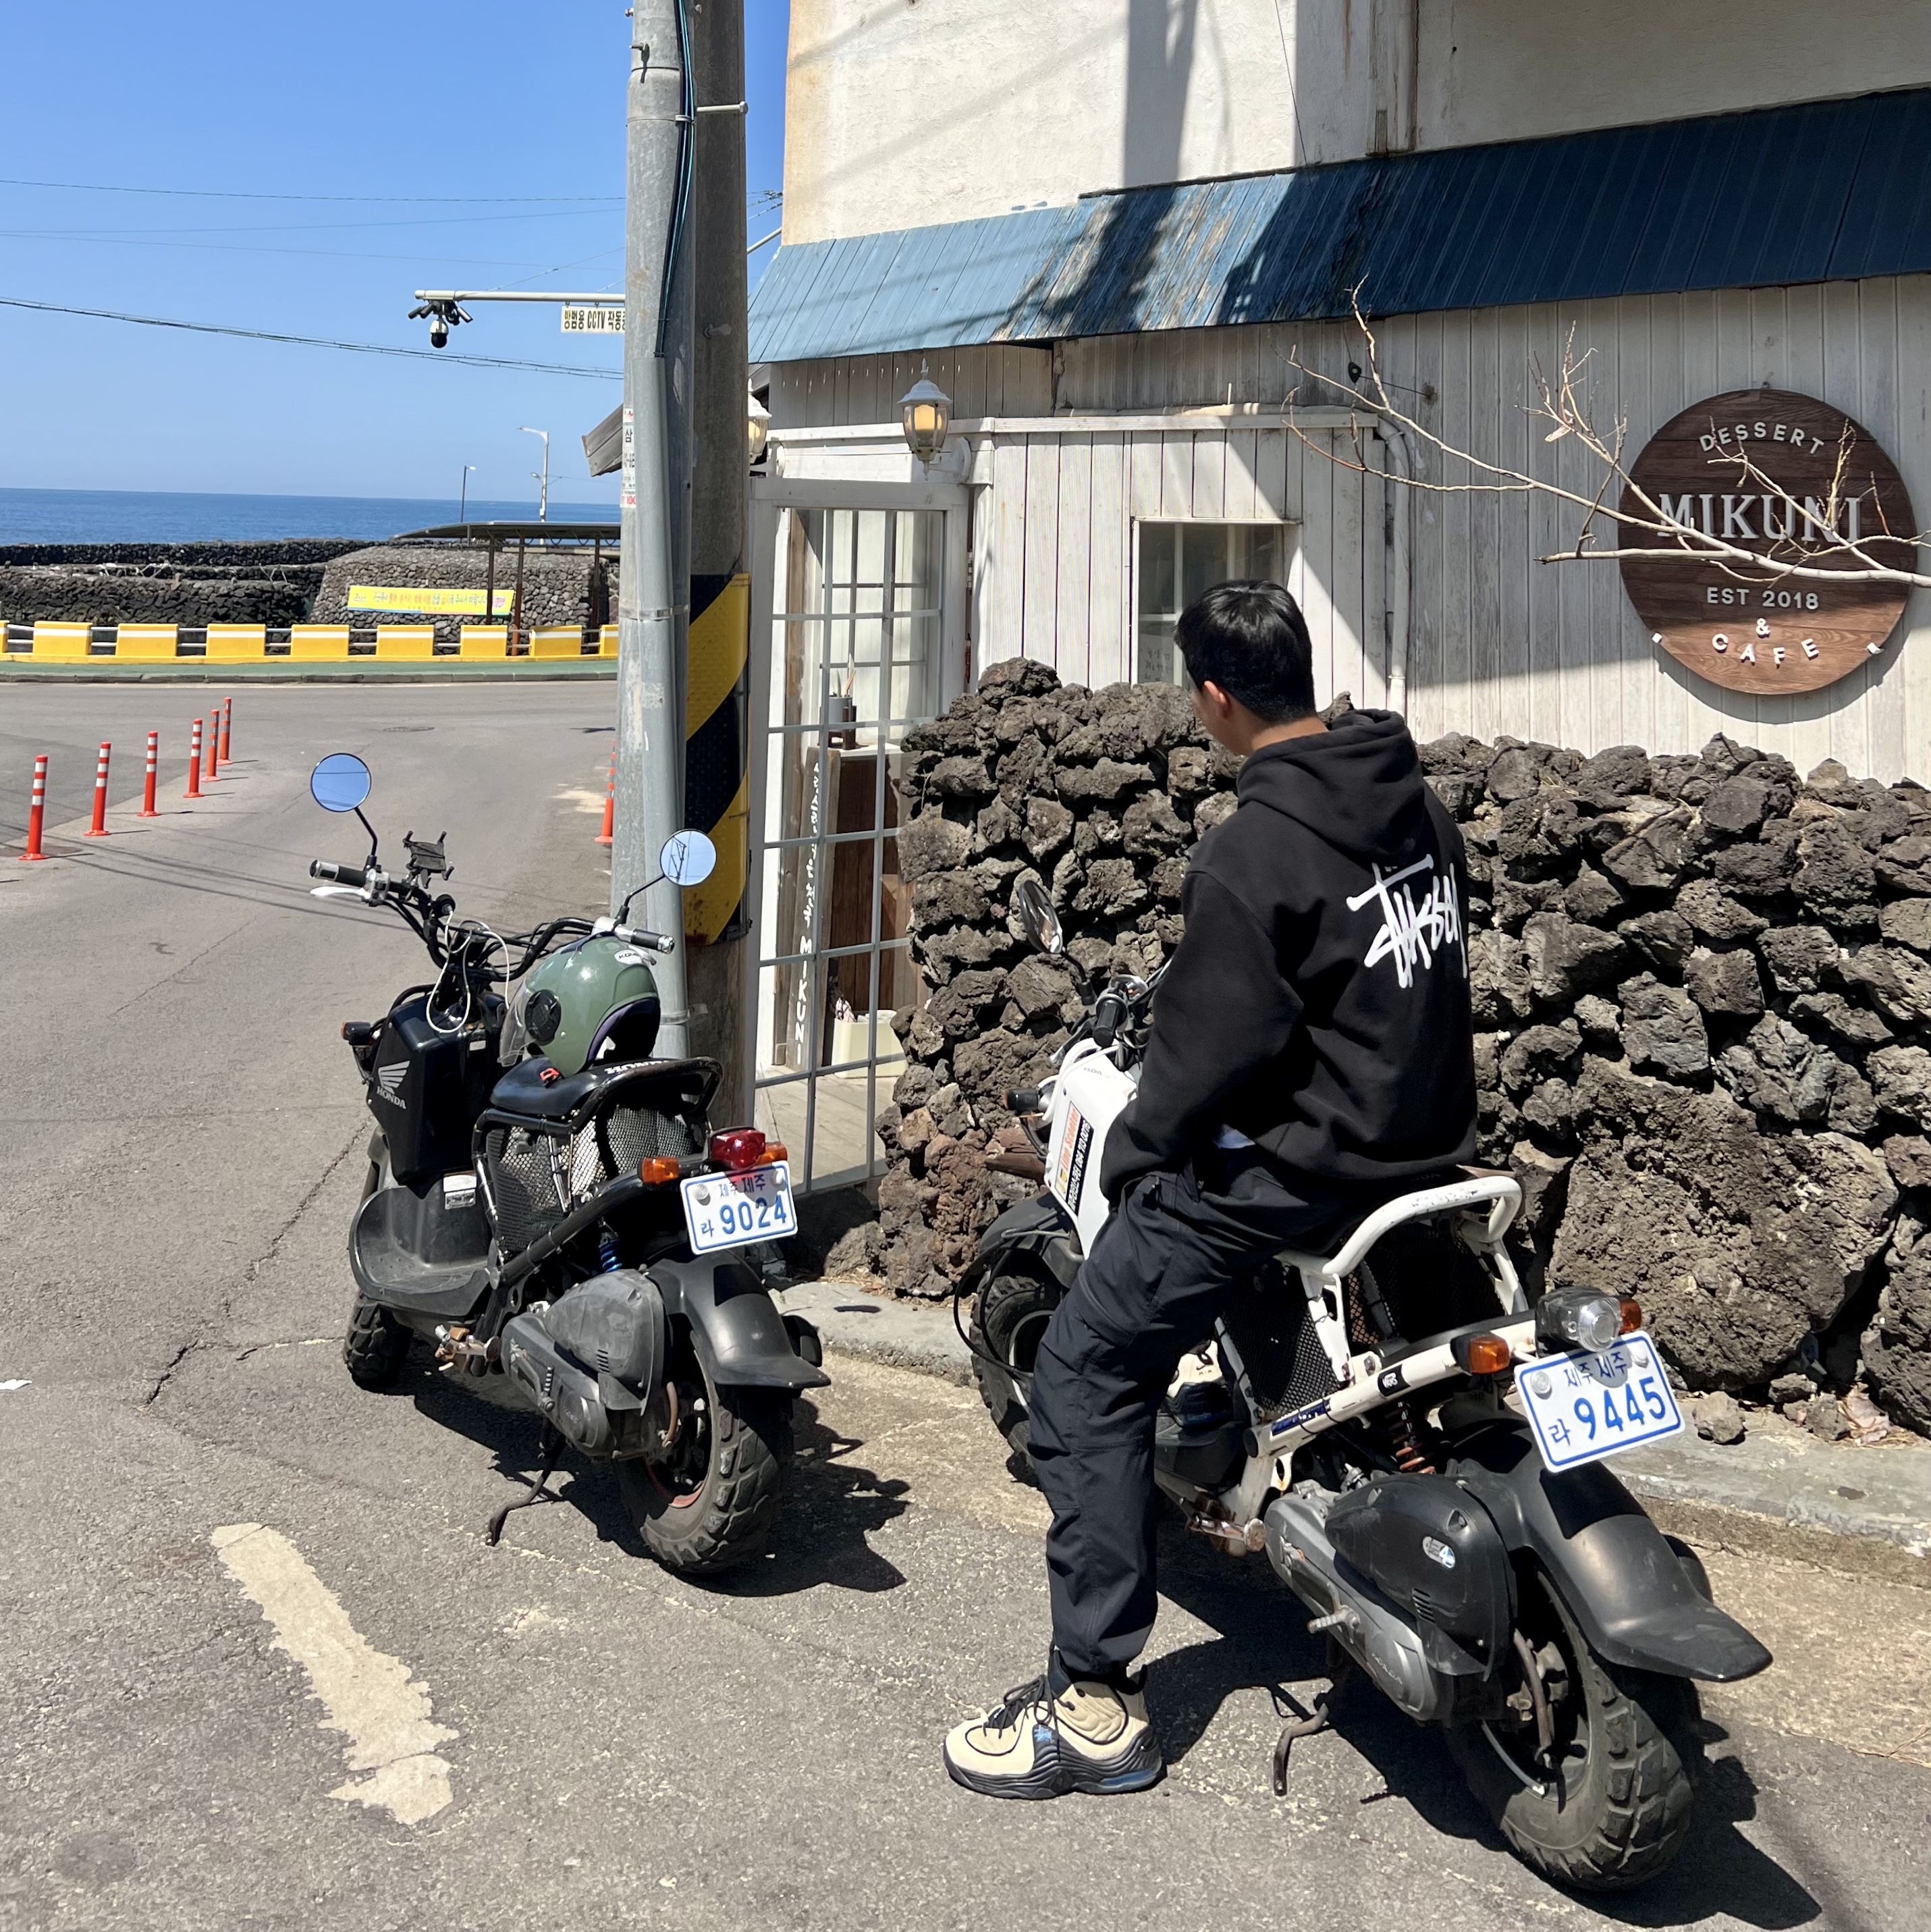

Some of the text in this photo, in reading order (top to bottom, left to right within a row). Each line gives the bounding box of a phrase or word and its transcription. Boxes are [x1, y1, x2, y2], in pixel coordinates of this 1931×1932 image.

[564, 310, 584, 329] 방범용
[587, 311, 606, 329] CCTV
[1699, 421, 1825, 455] DESSERT
[1656, 493, 1863, 543] MIKUNI
[1706, 587, 1820, 610] EST 2018
[1756, 618, 1770, 637] &
[1712, 633, 1820, 668] CAFE
[795, 935, 812, 1065] MIKUNI
[376, 1086, 407, 1110] HONDA
[1060, 1108, 1079, 1172] Line Scooter
[718, 1174, 766, 1197] 제주 제주
[701, 1194, 787, 1237] 라 9024
[1563, 1351, 1627, 1387] 제주 제주
[1548, 1376, 1666, 1446] 라 9445
